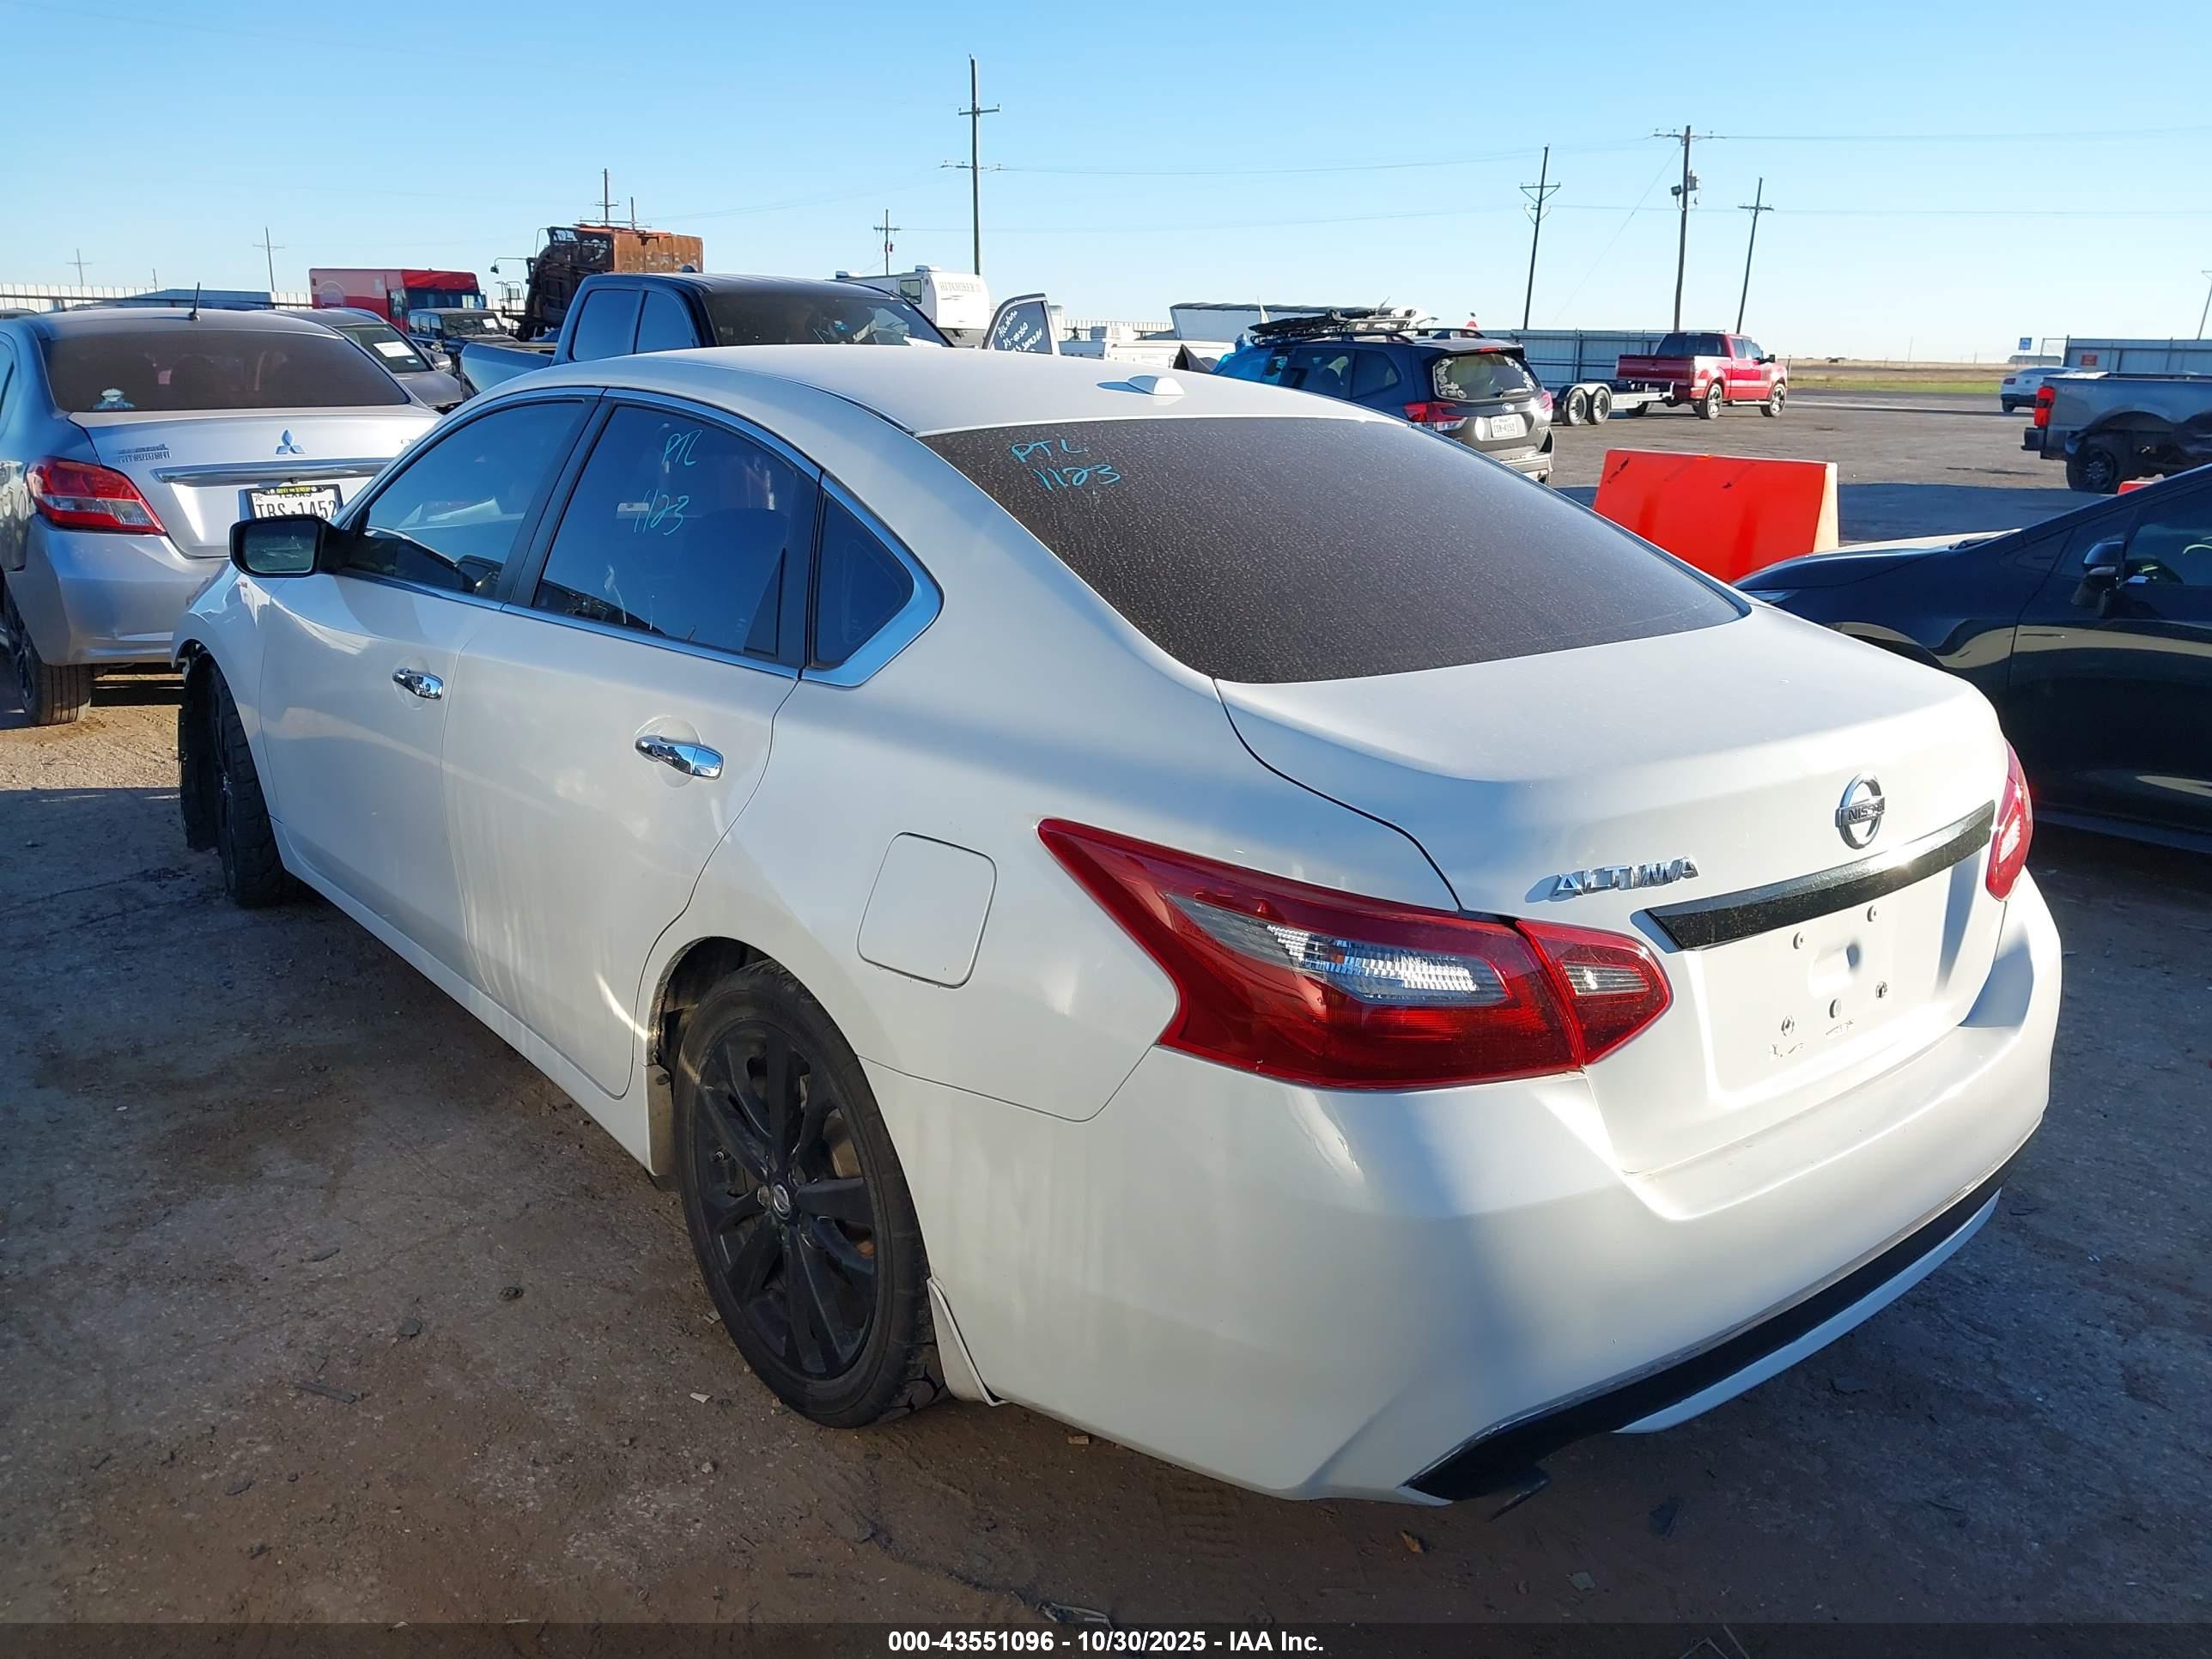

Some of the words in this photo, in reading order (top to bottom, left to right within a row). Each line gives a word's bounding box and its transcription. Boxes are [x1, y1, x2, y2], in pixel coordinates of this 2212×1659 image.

[1012, 439, 1087, 462] PTL
[1031, 464, 1120, 491] 1123
[1553, 857, 1698, 896] ALTIMA
